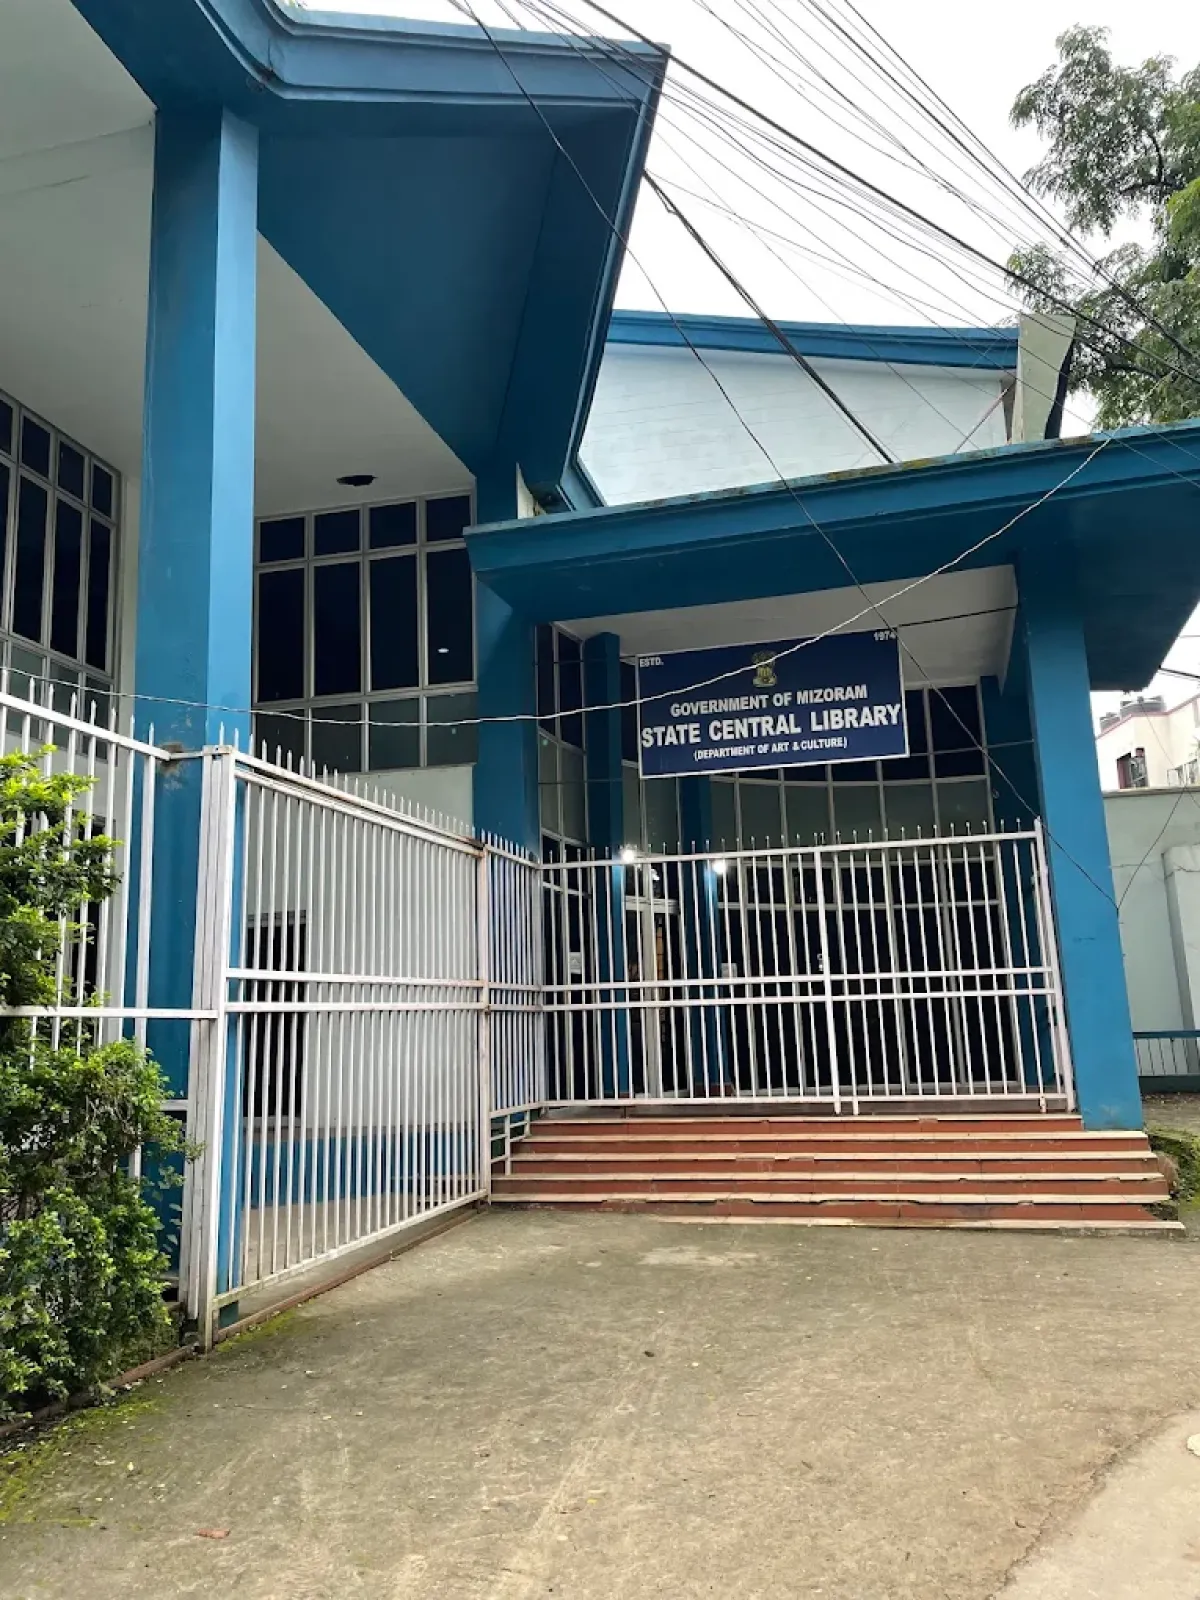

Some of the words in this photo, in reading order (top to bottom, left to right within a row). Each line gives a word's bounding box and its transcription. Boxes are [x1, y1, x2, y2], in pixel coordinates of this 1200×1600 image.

[671, 695, 768, 717] GOVERNMENT
[773, 691, 793, 705] OF
[797, 684, 868, 704] MIZORAM
[641, 722, 701, 748] STATE
[708, 714, 802, 740] CENTRAL
[810, 703, 901, 731] LIBRARY
[694, 746, 755, 761] (DEPARTMENT
[757, 744, 769, 754] OF
[772, 742, 789, 753] ART
[792, 742, 799, 751] &
[801, 737, 848, 750] CULTURE)
